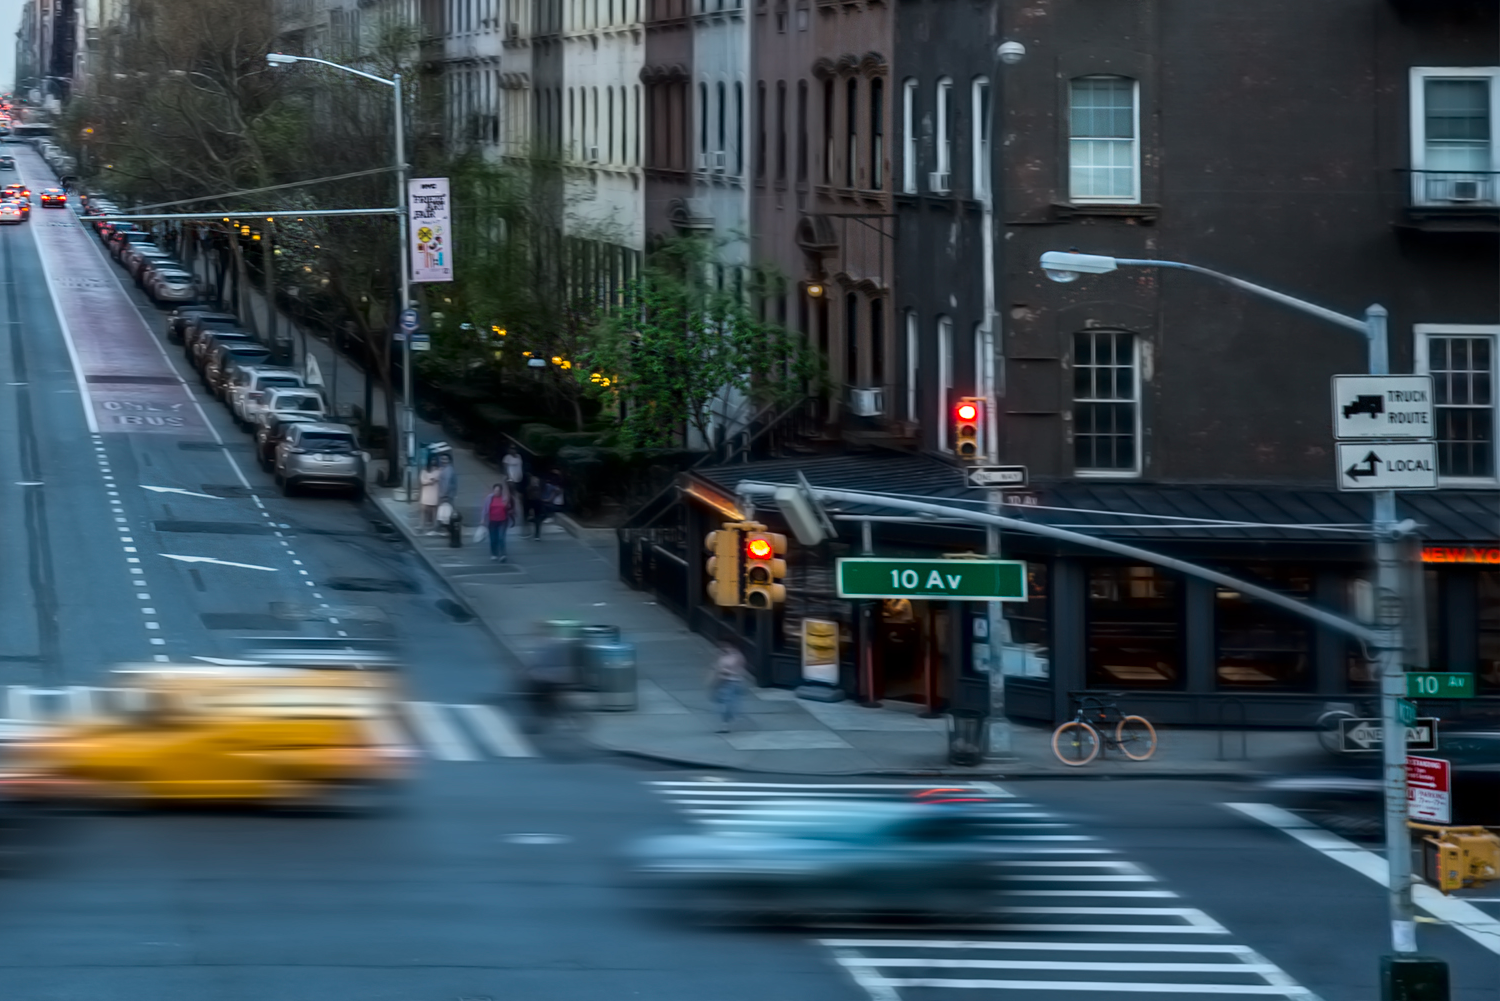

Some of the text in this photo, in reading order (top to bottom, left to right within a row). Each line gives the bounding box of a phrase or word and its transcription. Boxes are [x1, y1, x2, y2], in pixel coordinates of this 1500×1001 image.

[1386, 390, 1428, 402] TRUCK
[1387, 412, 1429, 424] ROUTE
[1386, 459, 1434, 472] LOCAL
[1421, 547, 1467, 563] NEW
[890, 569, 962, 589] 10 Av
[1415, 676, 1439, 694] 10
[1407, 729, 1424, 740] AY
